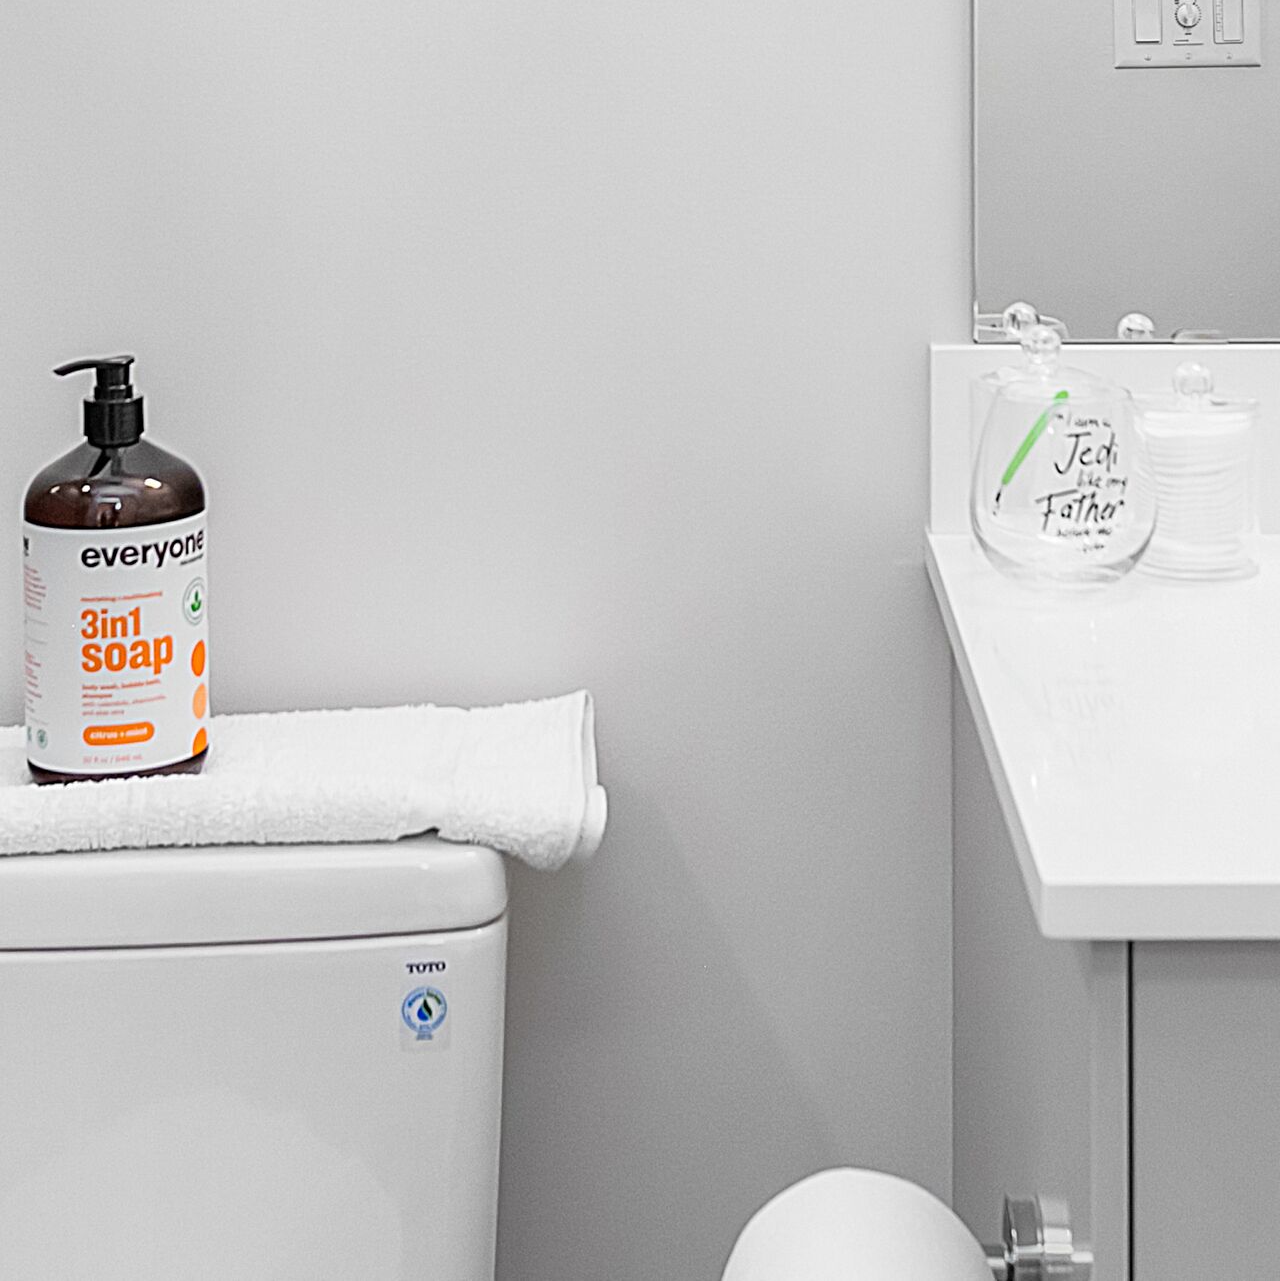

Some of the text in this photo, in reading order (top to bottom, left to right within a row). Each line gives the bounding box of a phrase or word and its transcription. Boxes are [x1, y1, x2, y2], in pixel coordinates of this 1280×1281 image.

[1054, 431, 1119, 475] Jedi
[1035, 488, 1124, 532] Father
[81, 530, 204, 568] everyone
[80, 606, 141, 640] 3in1
[81, 635, 173, 675] soap
[406, 961, 446, 975] TOTO
